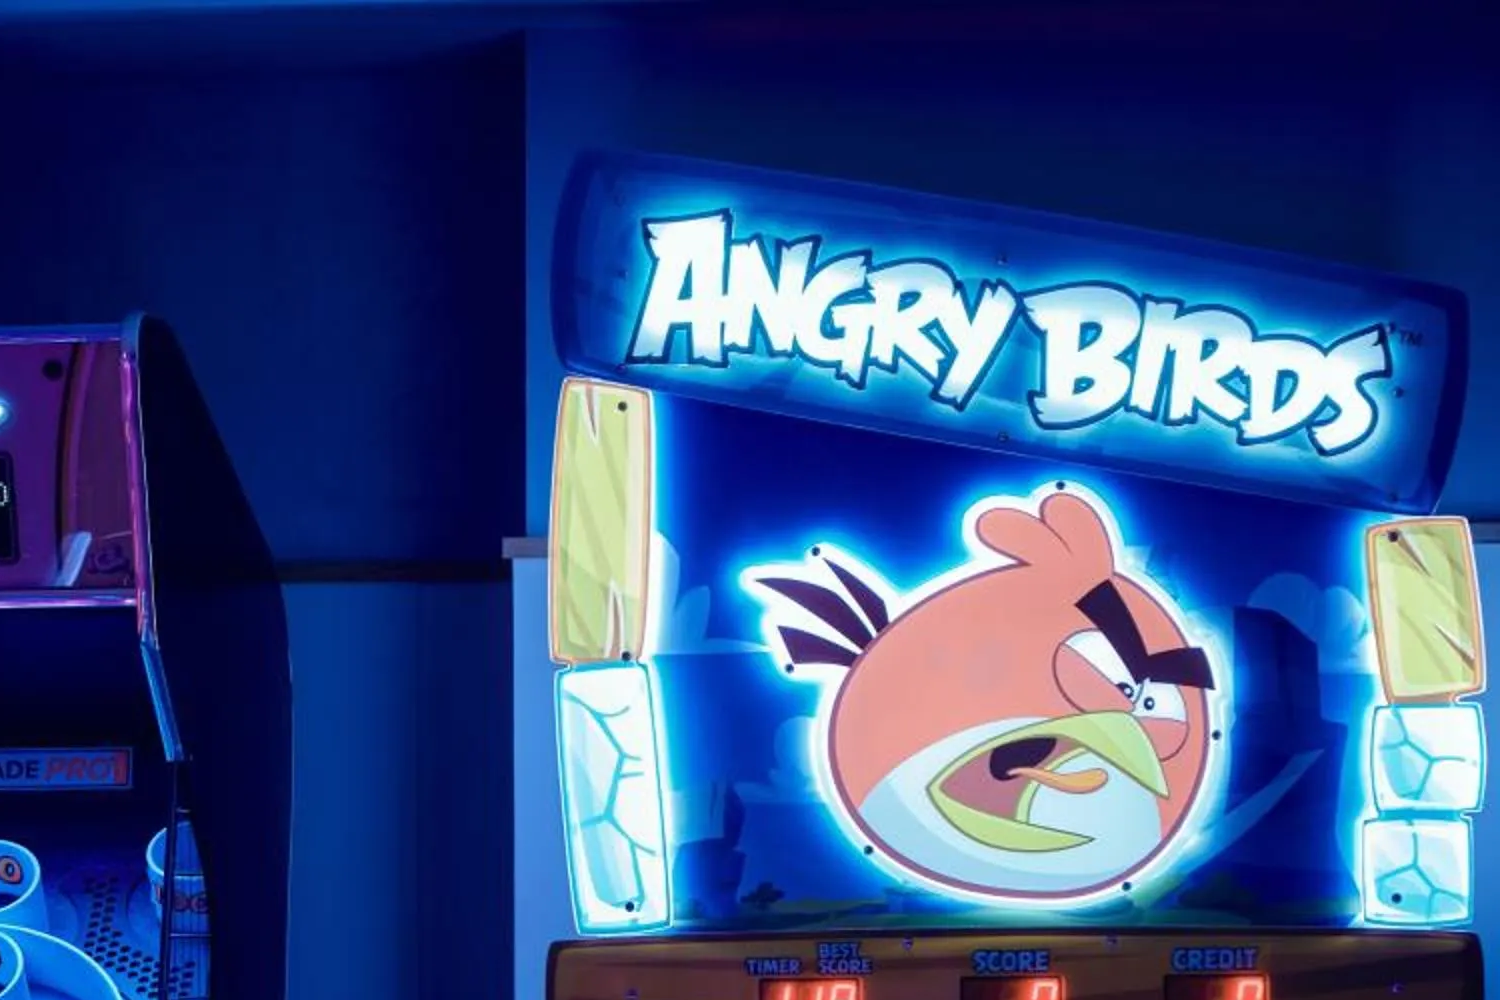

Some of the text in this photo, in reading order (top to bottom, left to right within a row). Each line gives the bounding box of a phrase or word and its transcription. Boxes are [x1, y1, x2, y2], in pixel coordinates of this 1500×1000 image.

[621, 207, 1017, 412] ANGRY
[1017, 280, 1395, 457] BIRDS
[817, 942, 859, 959] BEST
[1171, 948, 1257, 971] CREDIT
[746, 957, 800, 975] TIMER
[817, 958, 873, 975] SCORE
[971, 950, 1050, 973] SCORE
